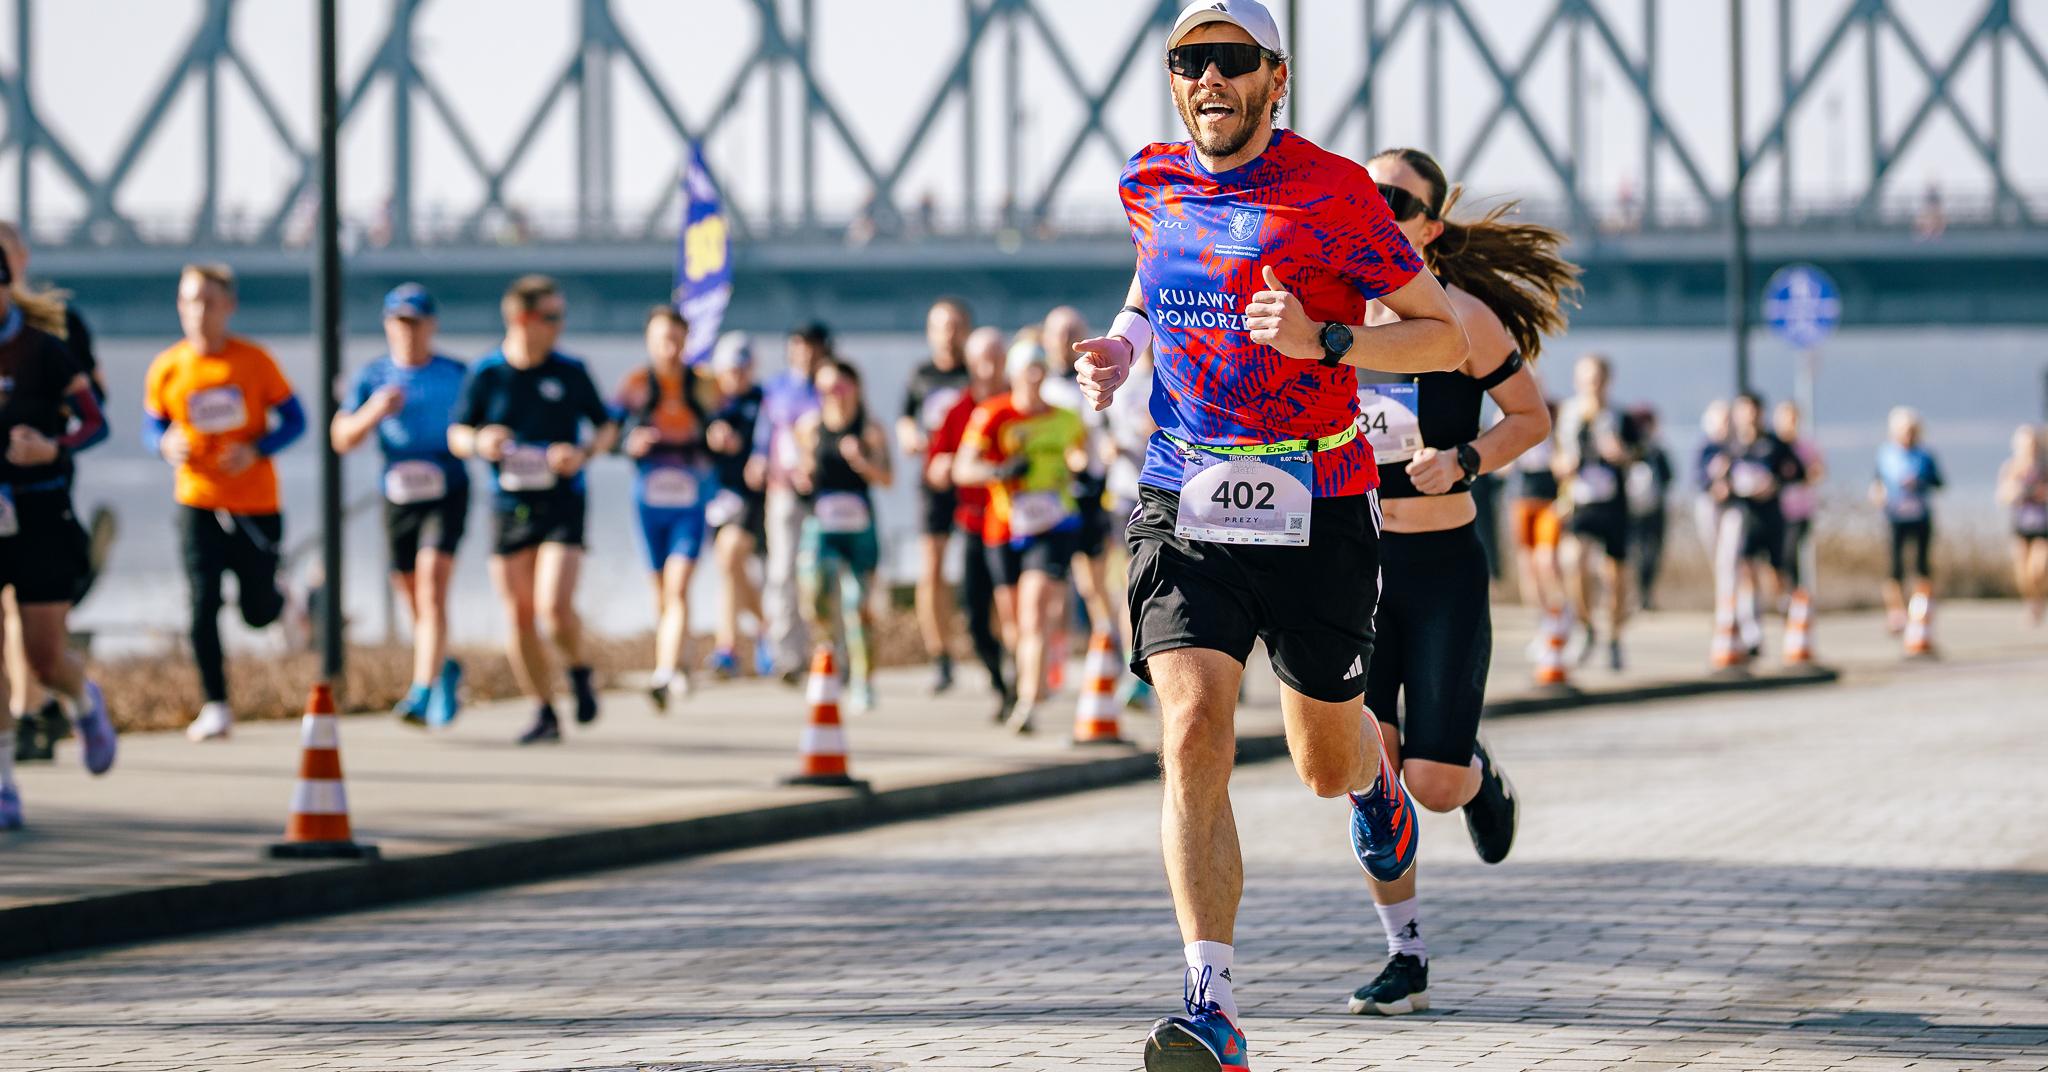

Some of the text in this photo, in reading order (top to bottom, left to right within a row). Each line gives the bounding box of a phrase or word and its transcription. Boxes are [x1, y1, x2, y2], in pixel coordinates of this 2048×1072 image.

[1159, 288, 1236, 310] KUJAWY
[1156, 309, 1250, 330] POMORZE
[1357, 411, 1388, 434] 34
[1228, 454, 1261, 462] TRYLOGIA
[1211, 481, 1275, 509] 402
